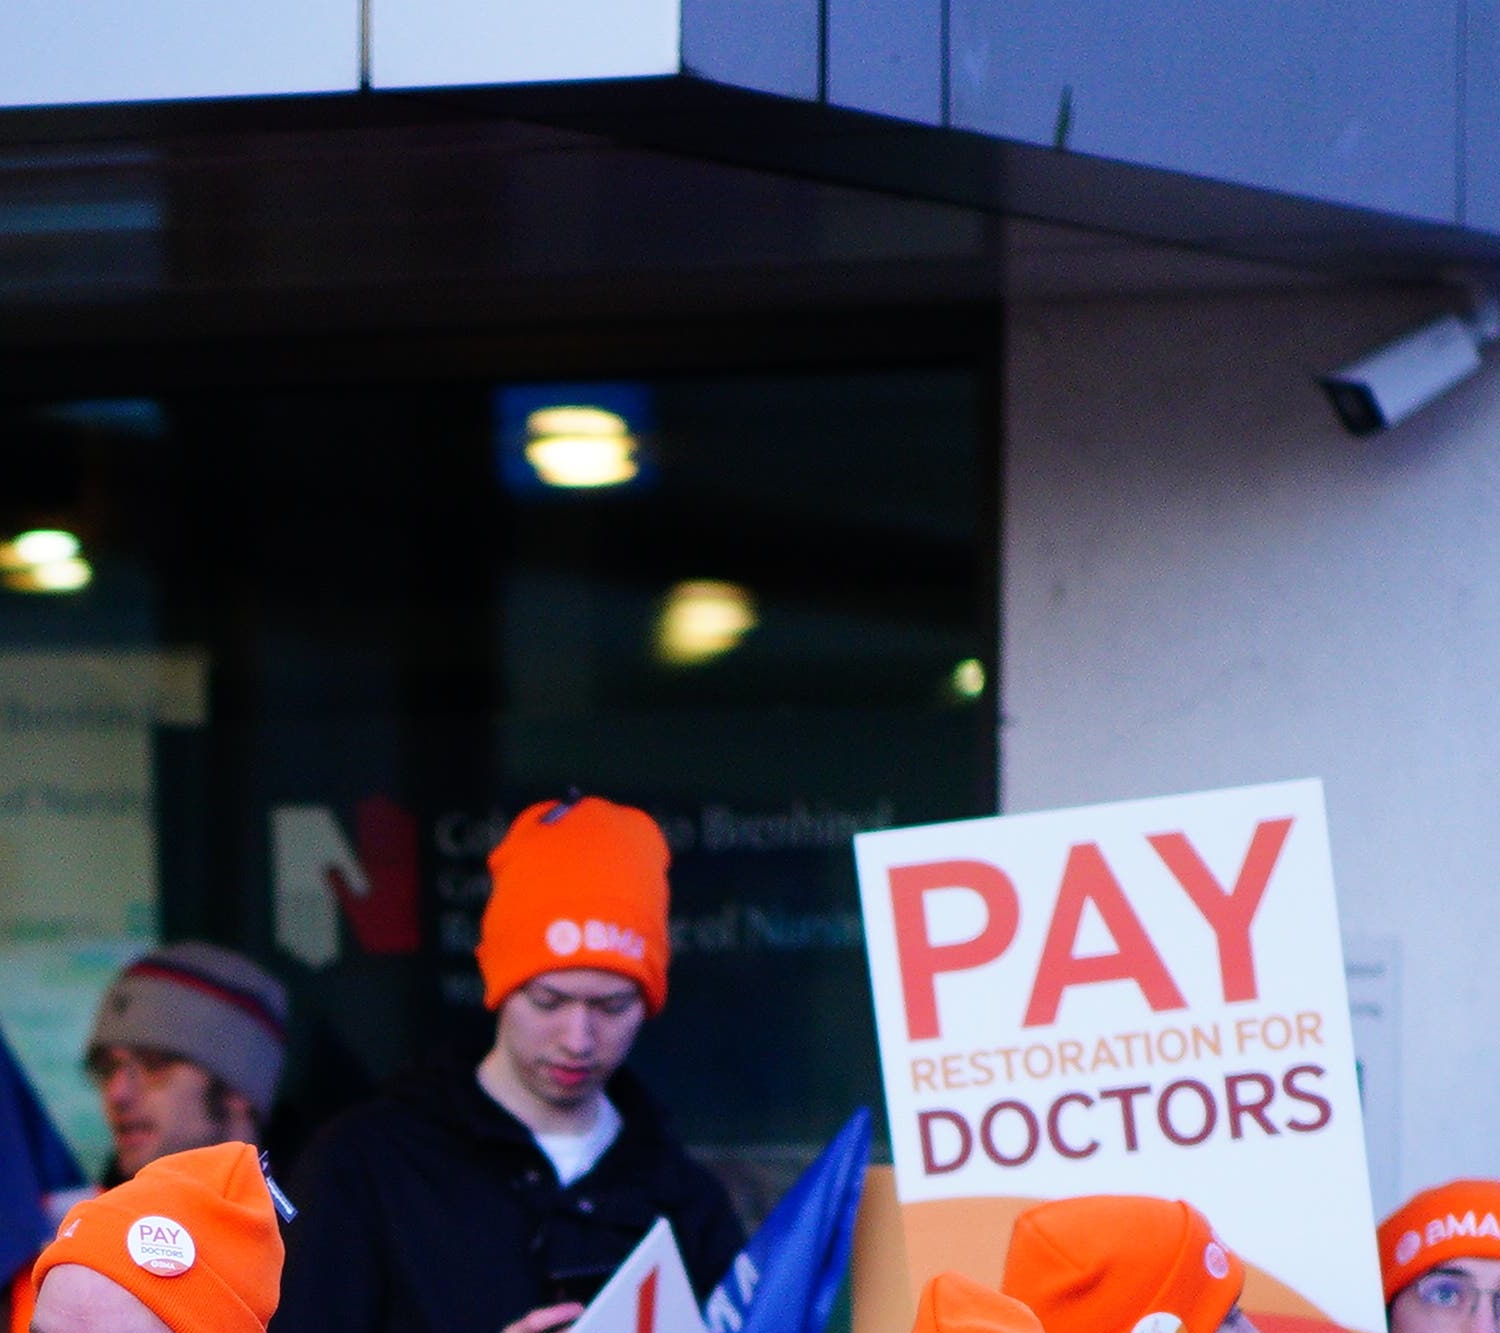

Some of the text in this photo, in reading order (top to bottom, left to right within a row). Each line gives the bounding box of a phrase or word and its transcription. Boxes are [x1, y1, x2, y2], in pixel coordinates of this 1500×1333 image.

[886, 815, 1298, 1043] PAY
[909, 1010, 1325, 1093] RESTORATION FOR
[916, 1064, 1334, 1178] DOCTORS
[139, 1224, 181, 1246] PAY
